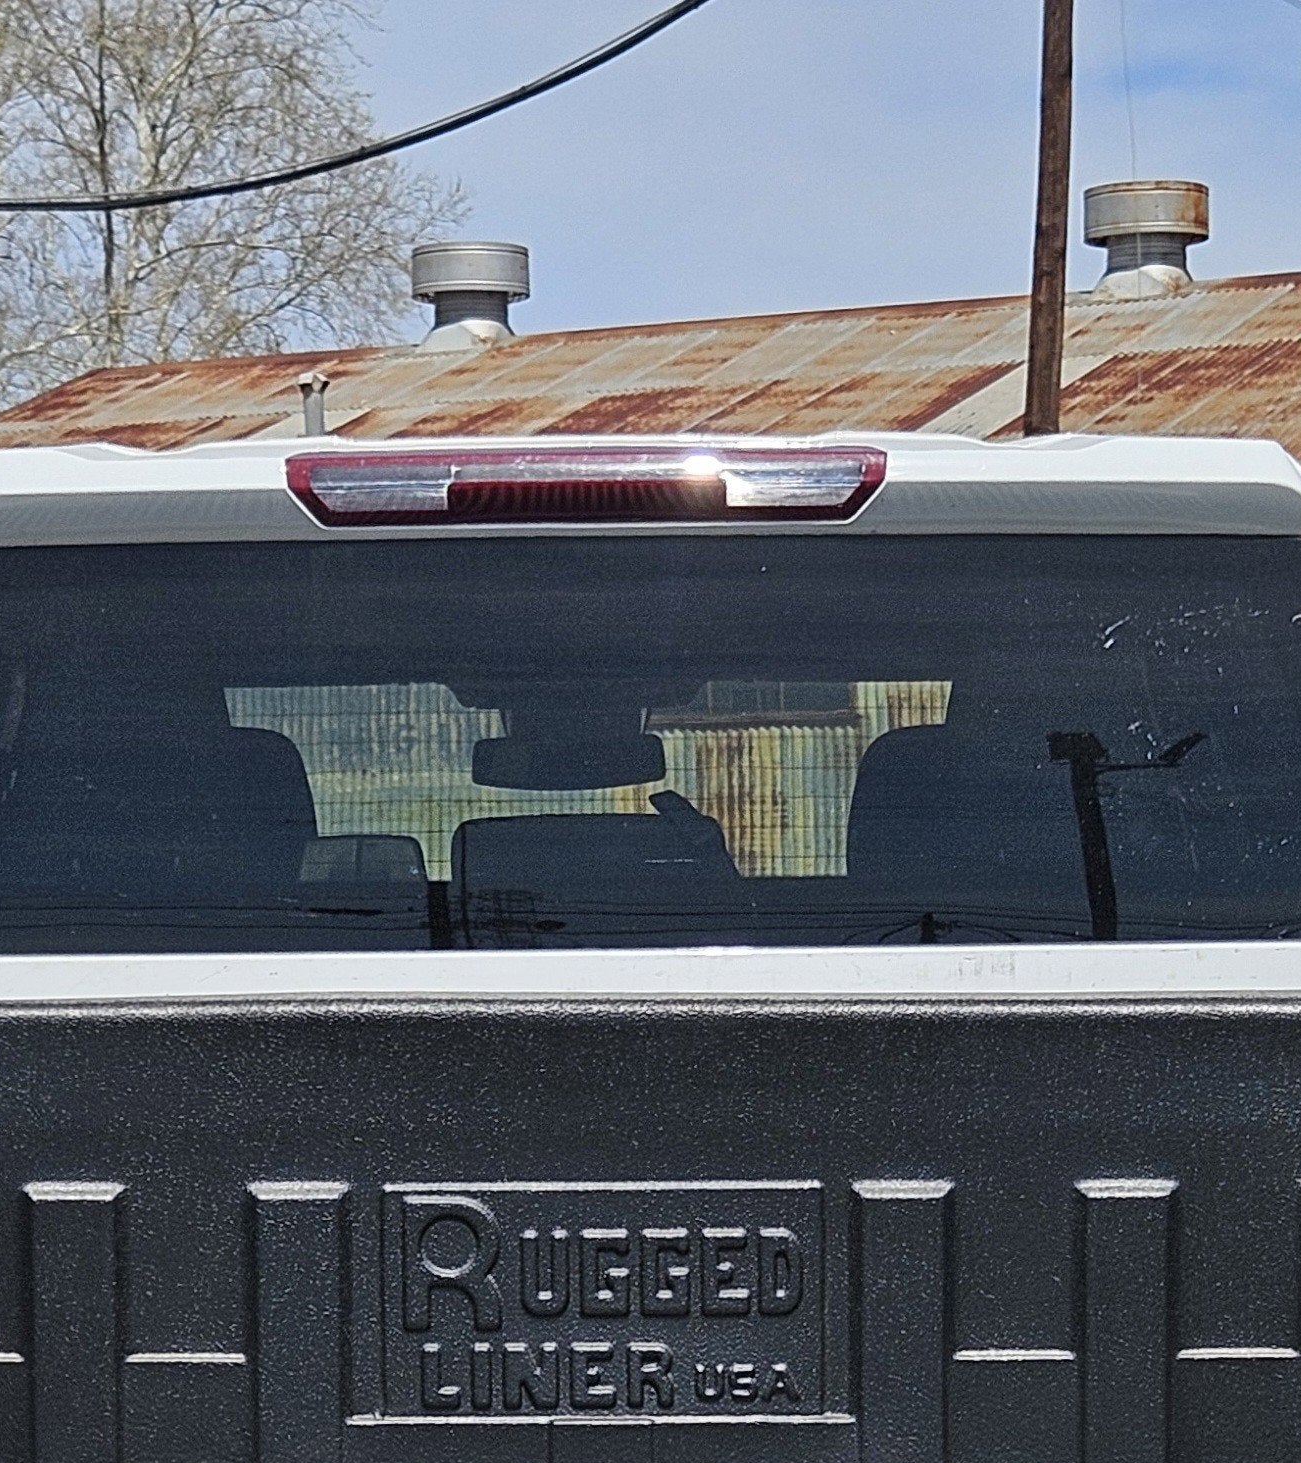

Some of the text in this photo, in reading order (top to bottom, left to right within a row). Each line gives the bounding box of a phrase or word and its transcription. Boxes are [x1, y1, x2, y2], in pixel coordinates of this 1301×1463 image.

[401, 1196, 799, 1333] RUGGED
[419, 1342, 799, 1410] LINER USA
